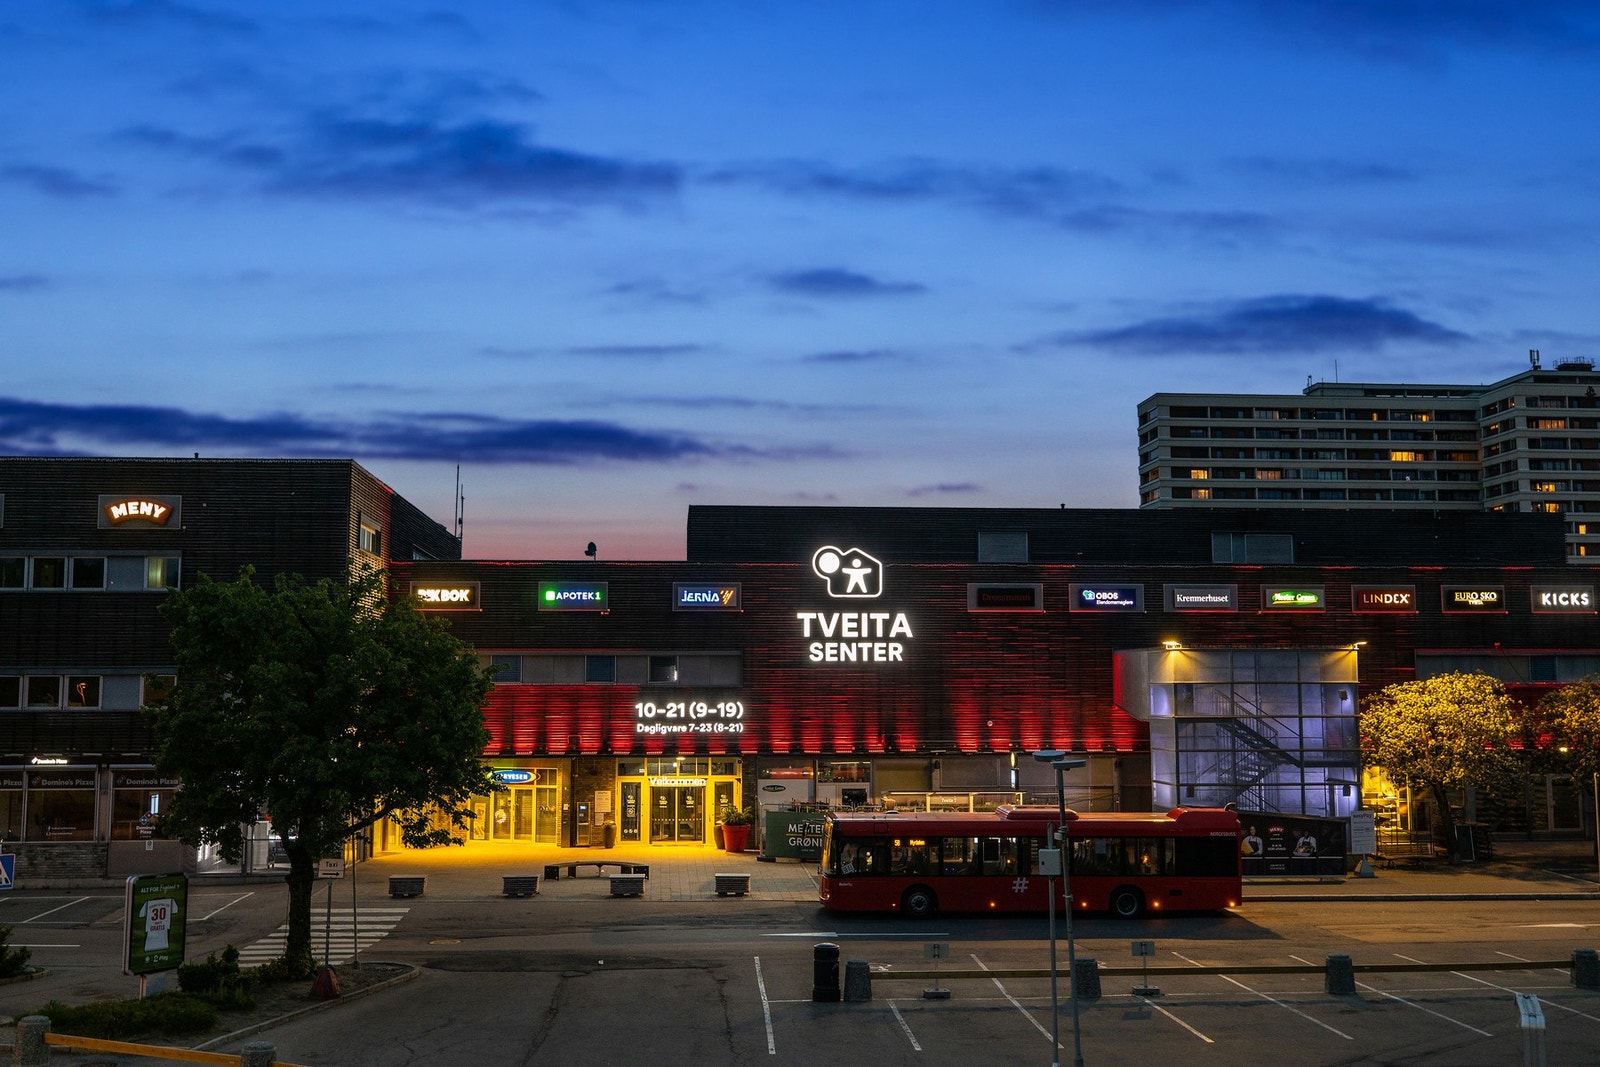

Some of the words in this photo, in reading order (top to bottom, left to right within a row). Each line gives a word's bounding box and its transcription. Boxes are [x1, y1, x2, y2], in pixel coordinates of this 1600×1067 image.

[111, 501, 166, 519] MENY
[441, 589, 470, 602] BOK
[556, 591, 594, 600] APOTEK
[594, 591, 601, 600] 1
[1096, 592, 1119, 600] OBOS
[1177, 594, 1229, 602] Kremmerhuset
[1363, 593, 1409, 604] LINDEX
[1455, 592, 1479, 600] EURO
[1480, 591, 1497, 600] SKO
[1542, 593, 1589, 606] KICKS
[797, 612, 914, 638] TVEITA
[809, 642, 904, 662] SENTER
[636, 702, 686, 718] 10-21
[689, 701, 744, 720] (9-19)
[637, 724, 687, 734] Dagligvare
[688, 723, 713, 732] 7-23
[714, 723, 744, 733] (8-21)
[126, 777, 158, 785] Domino's
[160, 777, 179, 785] Pizza
[648, 775, 707, 786] Velkommen
[788, 824, 827, 834] METE
[788, 837, 823, 849] GRØN
[151, 907, 166, 921] 30
